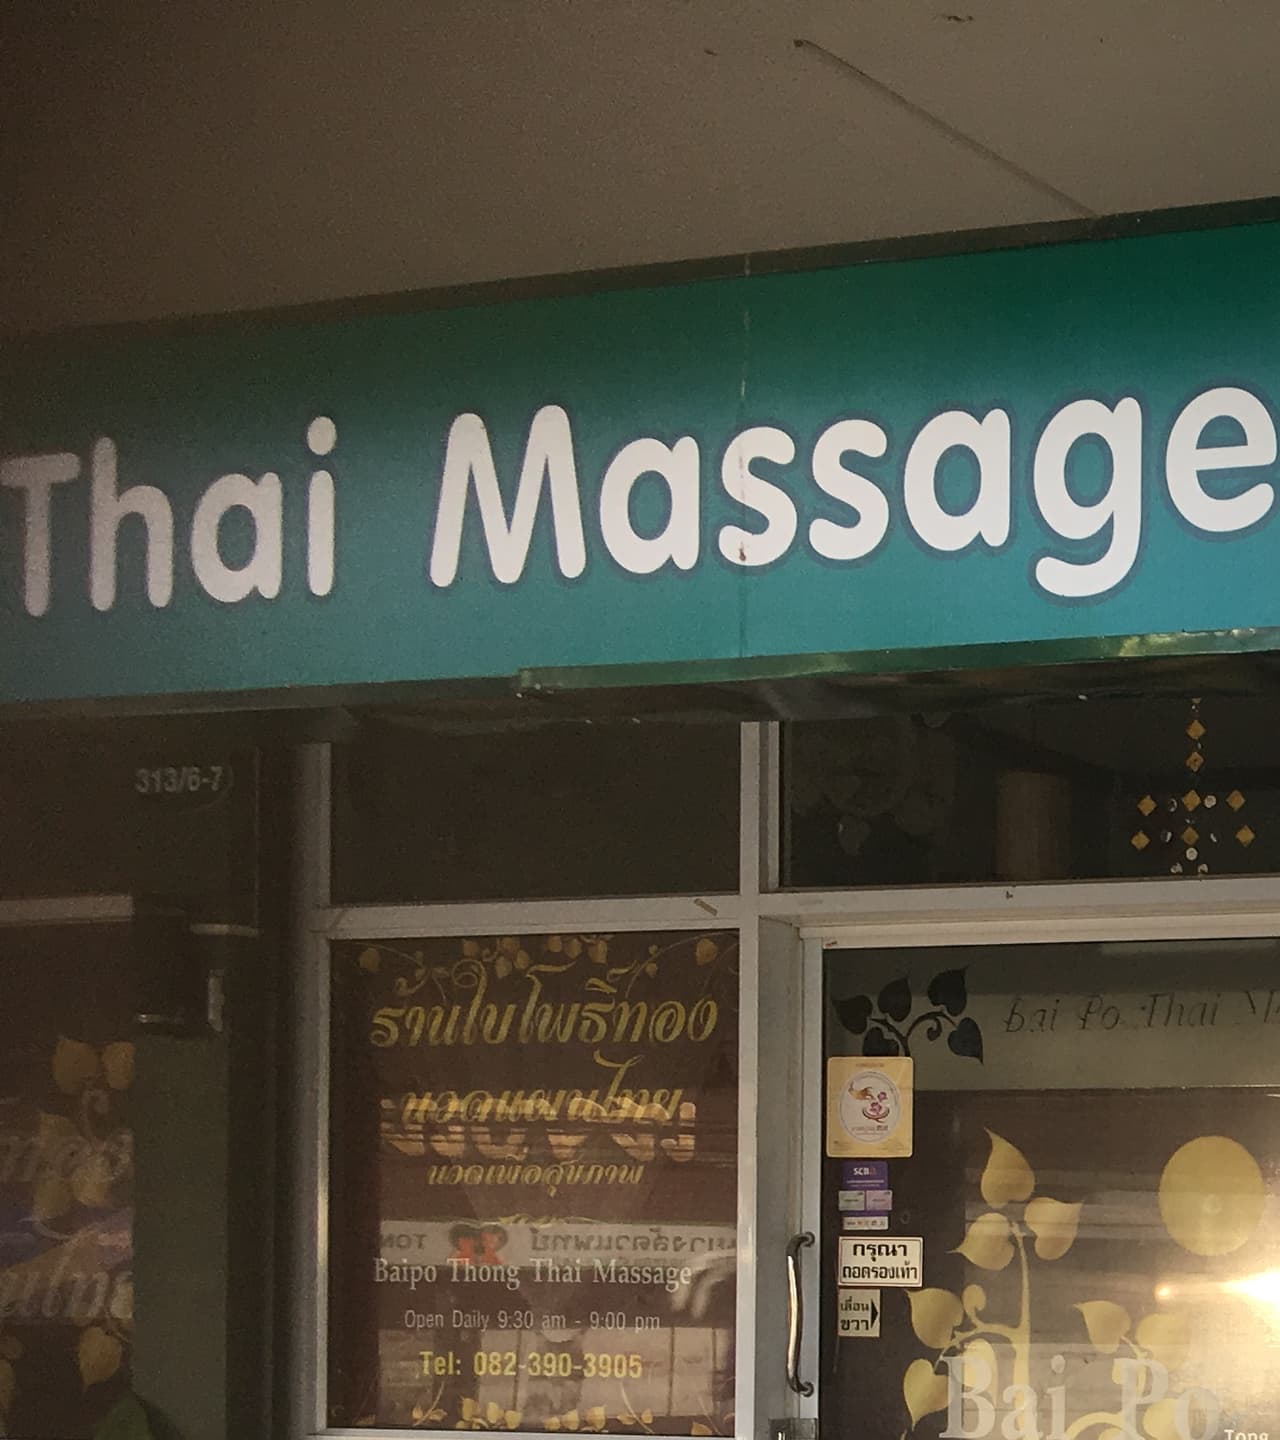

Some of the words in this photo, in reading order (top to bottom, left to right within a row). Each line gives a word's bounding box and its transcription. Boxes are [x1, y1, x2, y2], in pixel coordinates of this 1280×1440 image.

[1, 416, 337, 618] Thai
[429, 385, 1279, 597] Massage
[134, 765, 223, 793] 313/6-7
[852, 1243, 908, 1262] กรุณา
[373, 1257, 437, 1290] Baipo
[446, 1257, 521, 1291] Thong
[528, 1257, 582, 1284] Thai
[592, 1258, 693, 1292] Massage
[842, 1260, 918, 1280] ถอดรองเท้า
[404, 1309, 444, 1331] Open
[452, 1309, 490, 1332] Daily
[497, 1310, 535, 1330] 9:30
[540, 1314, 567, 1330] am
[588, 1311, 626, 1331] 9:00
[634, 1314, 661, 1333] pm
[840, 1319, 870, 1331] ขวา
[419, 1350, 462, 1376] Tel:
[473, 1351, 643, 1378] 082-390-3905
